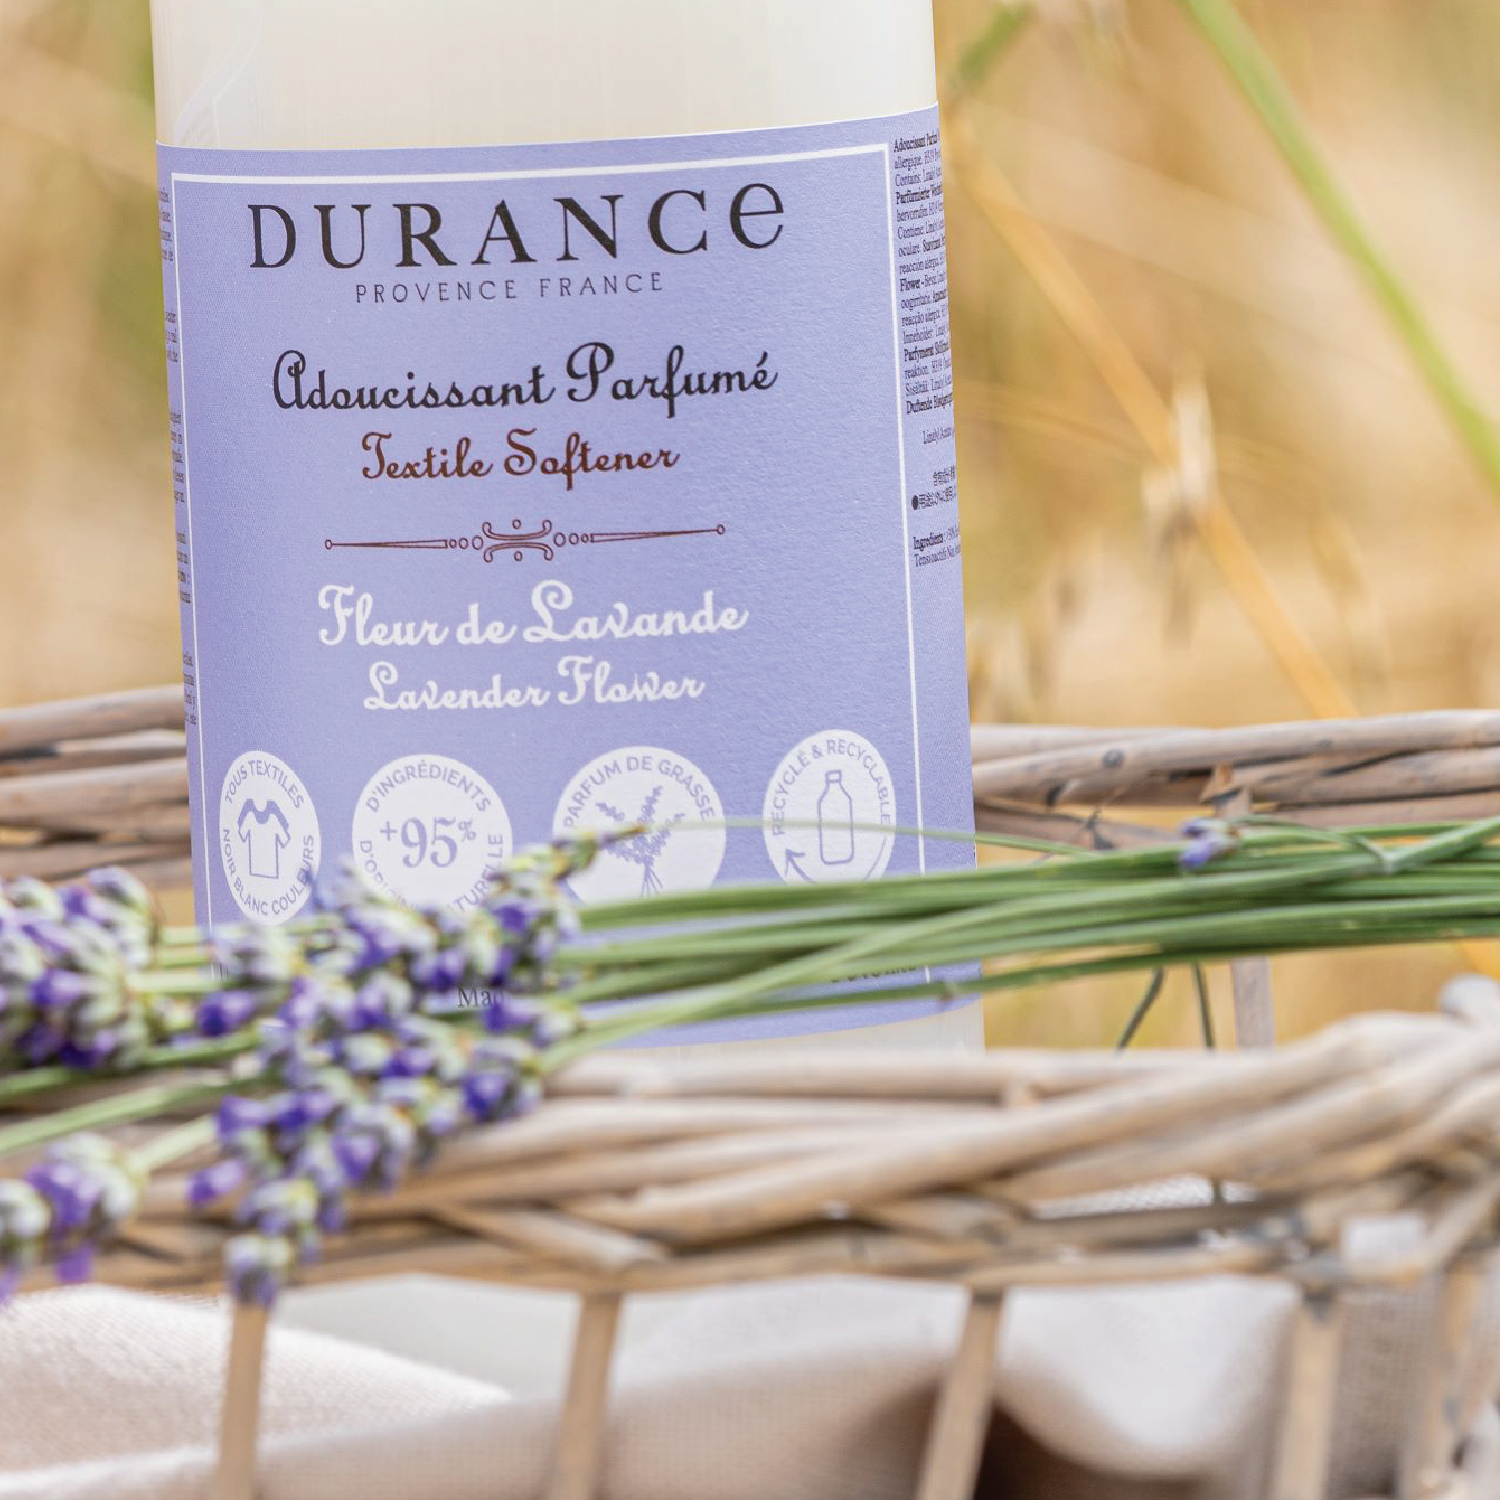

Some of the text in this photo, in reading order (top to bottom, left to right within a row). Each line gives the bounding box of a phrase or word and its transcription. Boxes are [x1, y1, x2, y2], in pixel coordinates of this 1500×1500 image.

[356, 272, 662, 303] PROVENCE FRANCE
[274, 342, 778, 419] Adoucissant Parfumé
[362, 428, 680, 491] Textile Softener
[318, 580, 749, 646] Fleur de Lavande
[363, 655, 706, 710] Lavender Flower
[224, 759, 305, 809] TOUS TEXTILES
[365, 759, 492, 814] D'INGRÉDIENTS
[563, 755, 717, 829] PARFUM DE GRASSE
[811, 744, 824, 760] &
[825, 738, 891, 825] RECYCLABLE
[223, 829, 237, 876] NOIR
[233, 876, 269, 917] BLANC
